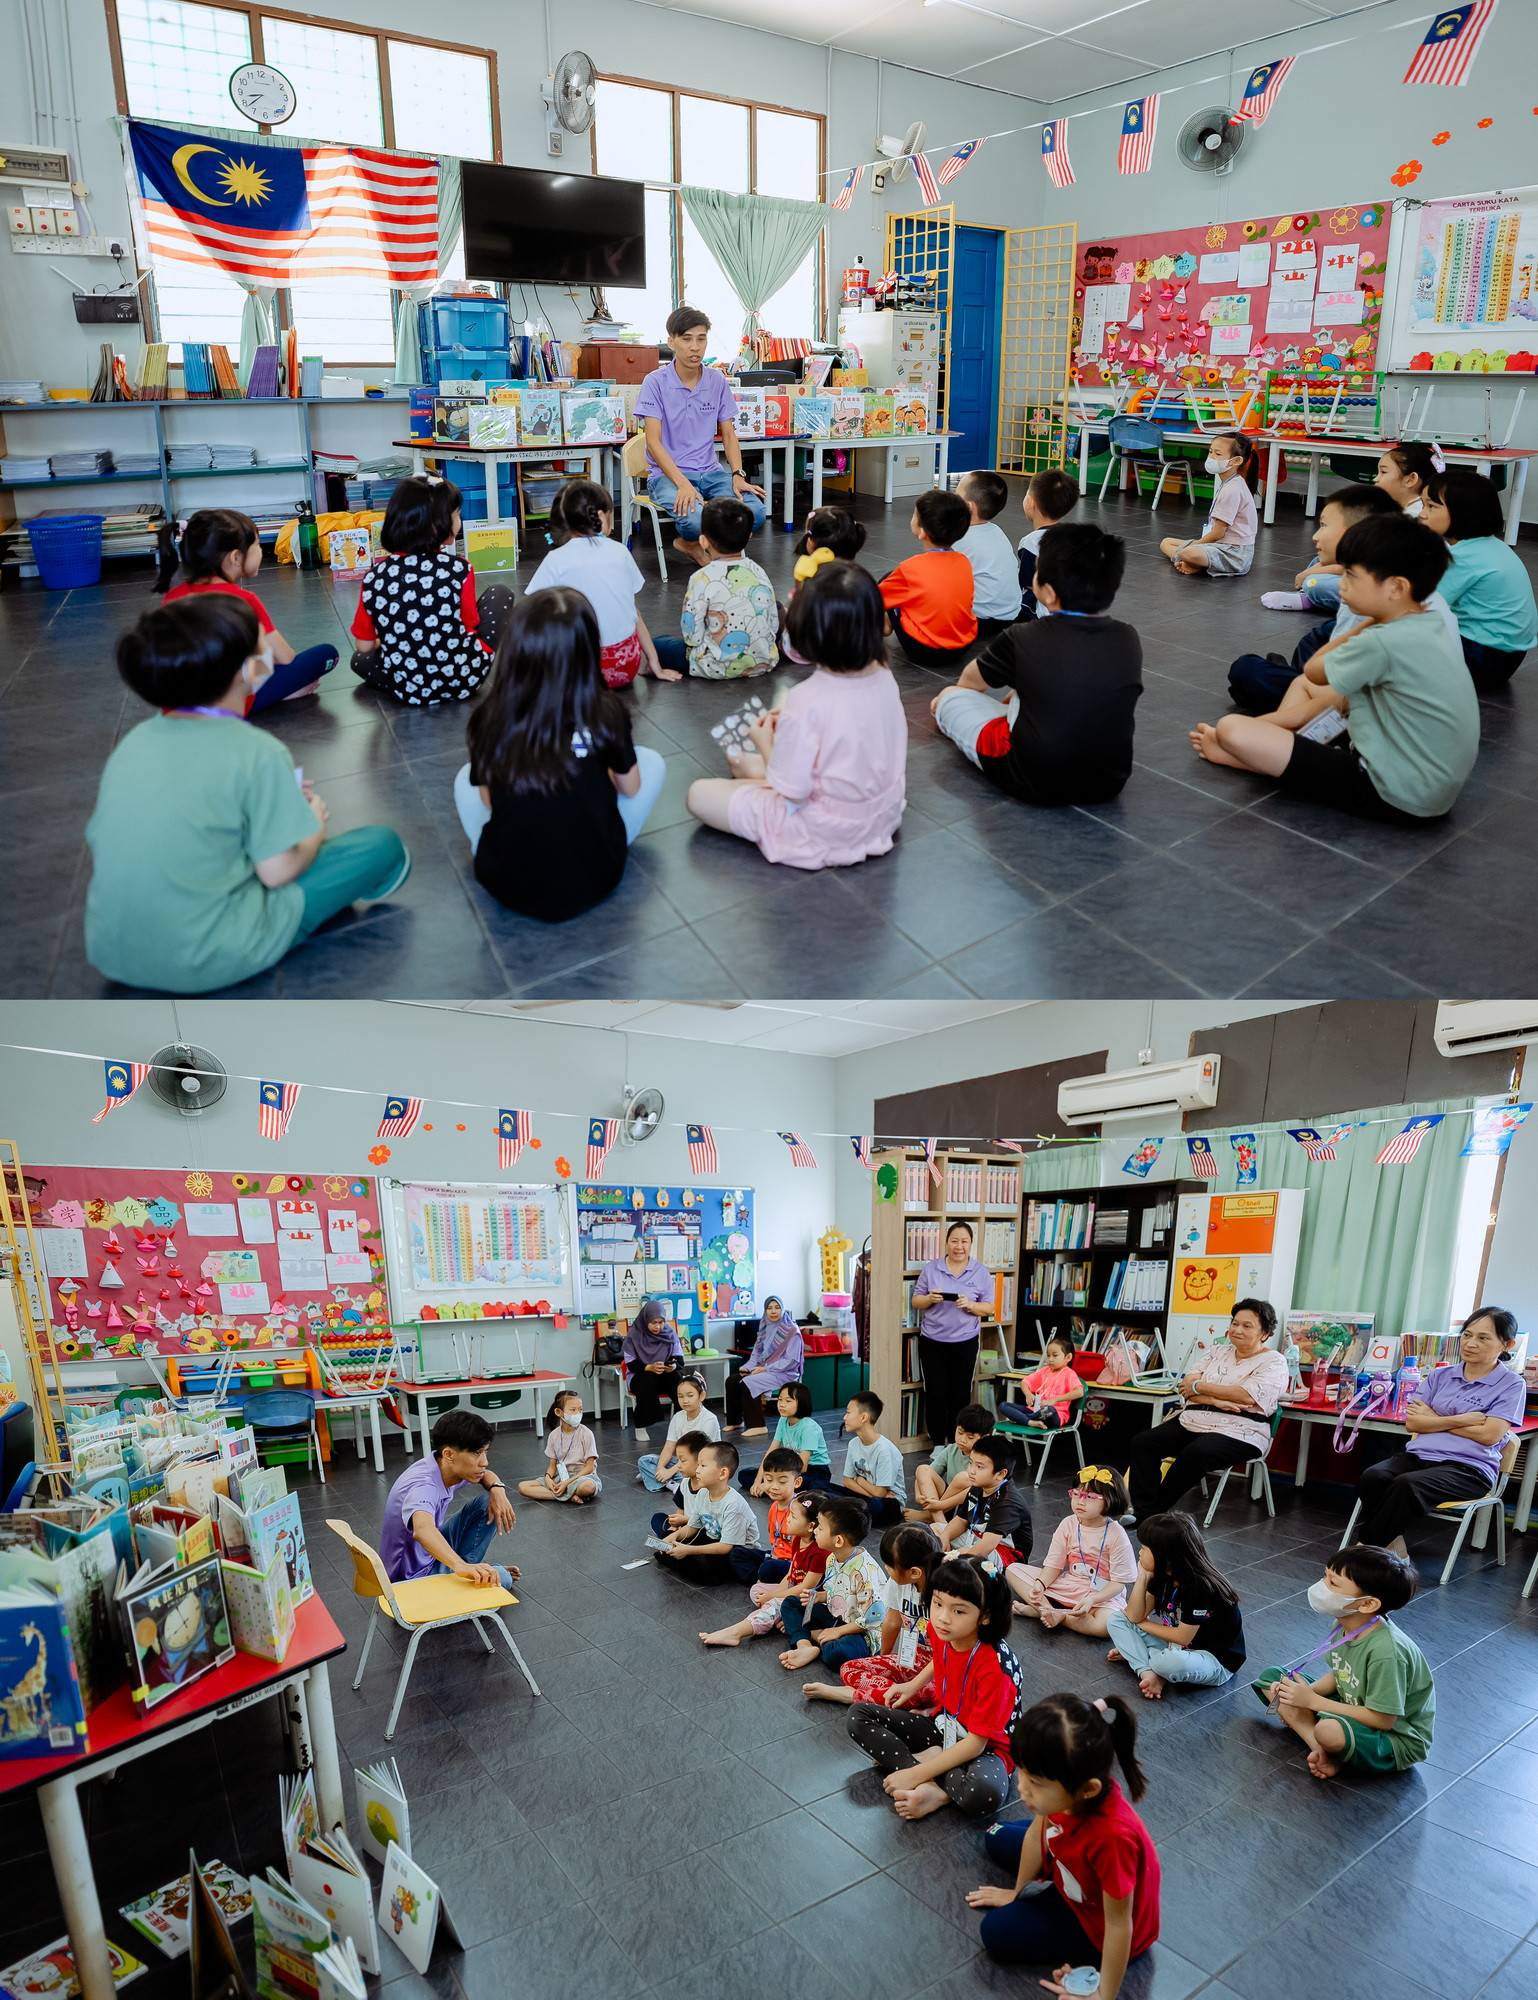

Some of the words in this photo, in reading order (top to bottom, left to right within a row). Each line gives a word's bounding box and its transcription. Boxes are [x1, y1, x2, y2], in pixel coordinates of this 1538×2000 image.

[257, 70, 265, 78] 12
[239, 78, 248, 86] 10
[279, 83, 285, 91] 2
[237, 88, 243, 96] 9
[284, 94, 289, 102] 3
[242, 99, 248, 107] 8
[252, 107, 257, 115] 7
[262, 112, 269, 120] 6
[1469, 205, 1501, 213] TERBUKA
[658, 1213, 678, 1223] Jadual
[678, 1214, 701, 1223] Waktu
[624, 1268, 634, 1280] A
[1372, 1346, 1389, 1360] a
[902, 1598, 929, 1618] PUM
